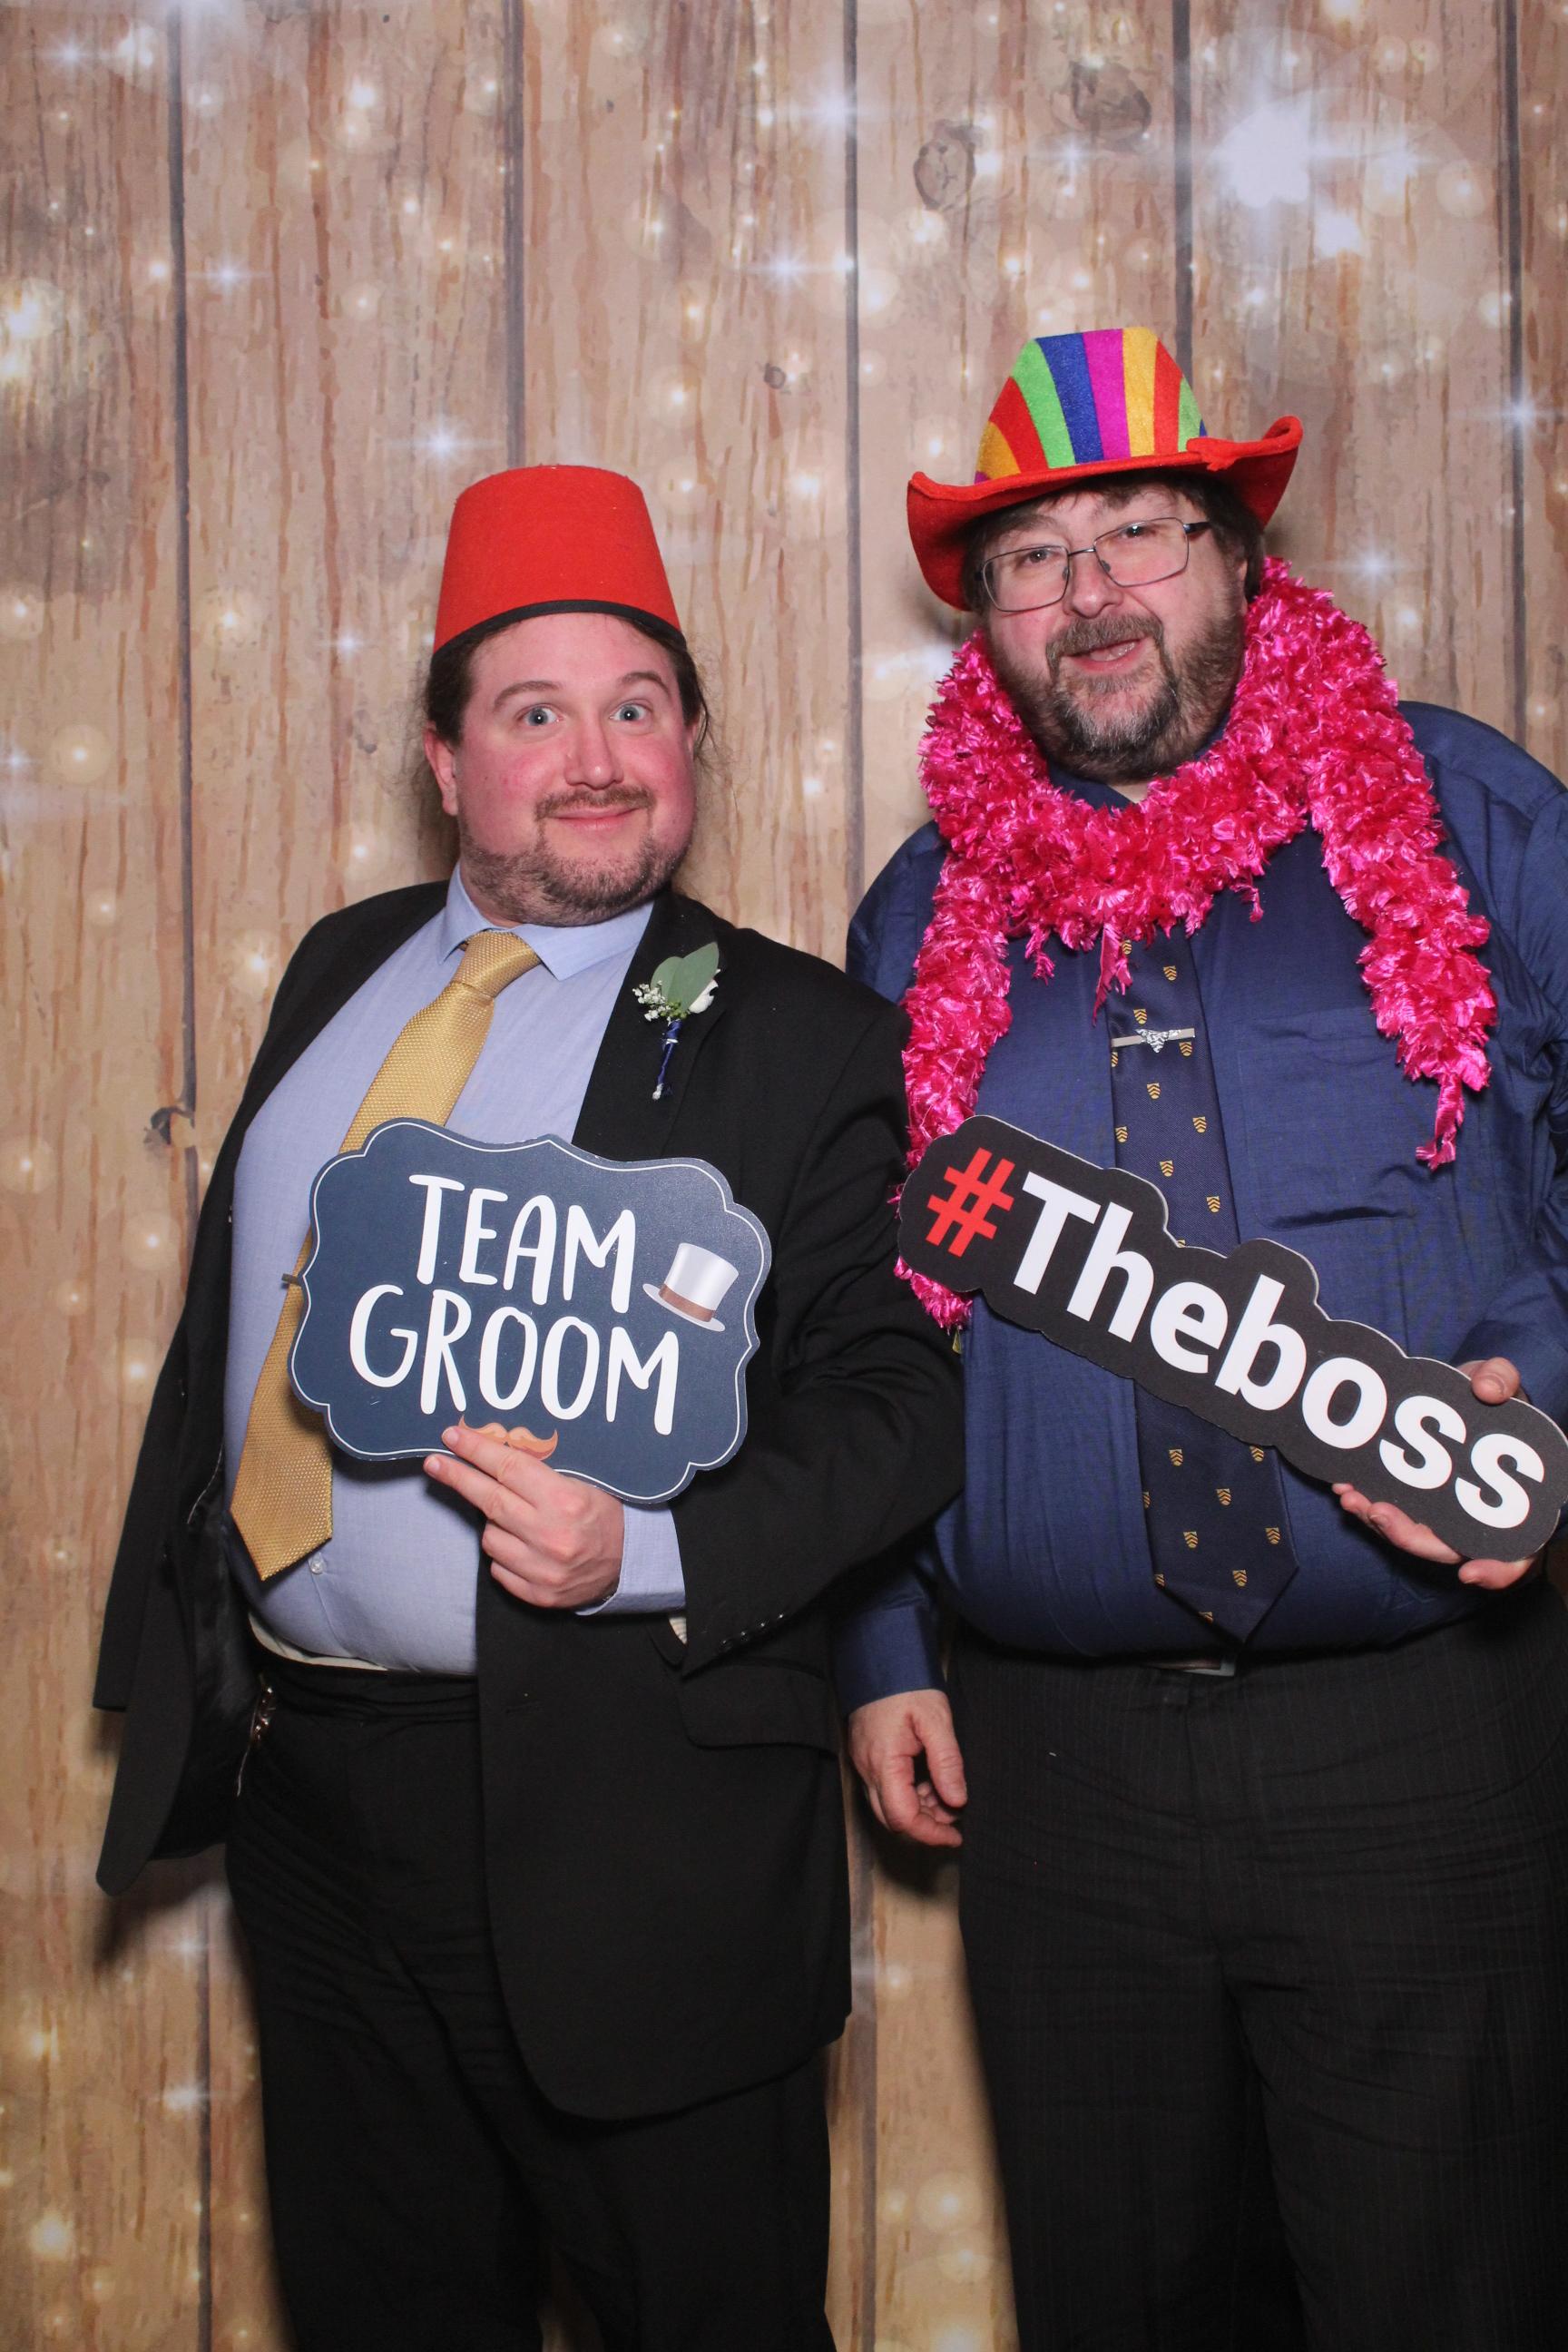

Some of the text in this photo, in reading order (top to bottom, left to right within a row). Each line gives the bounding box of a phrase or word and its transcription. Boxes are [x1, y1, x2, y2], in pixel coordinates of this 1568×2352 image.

[409, 1174, 636, 1314] TEAM
[349, 1284, 680, 1436] GROOM
[925, 1147, 1545, 1529] #Theboss
